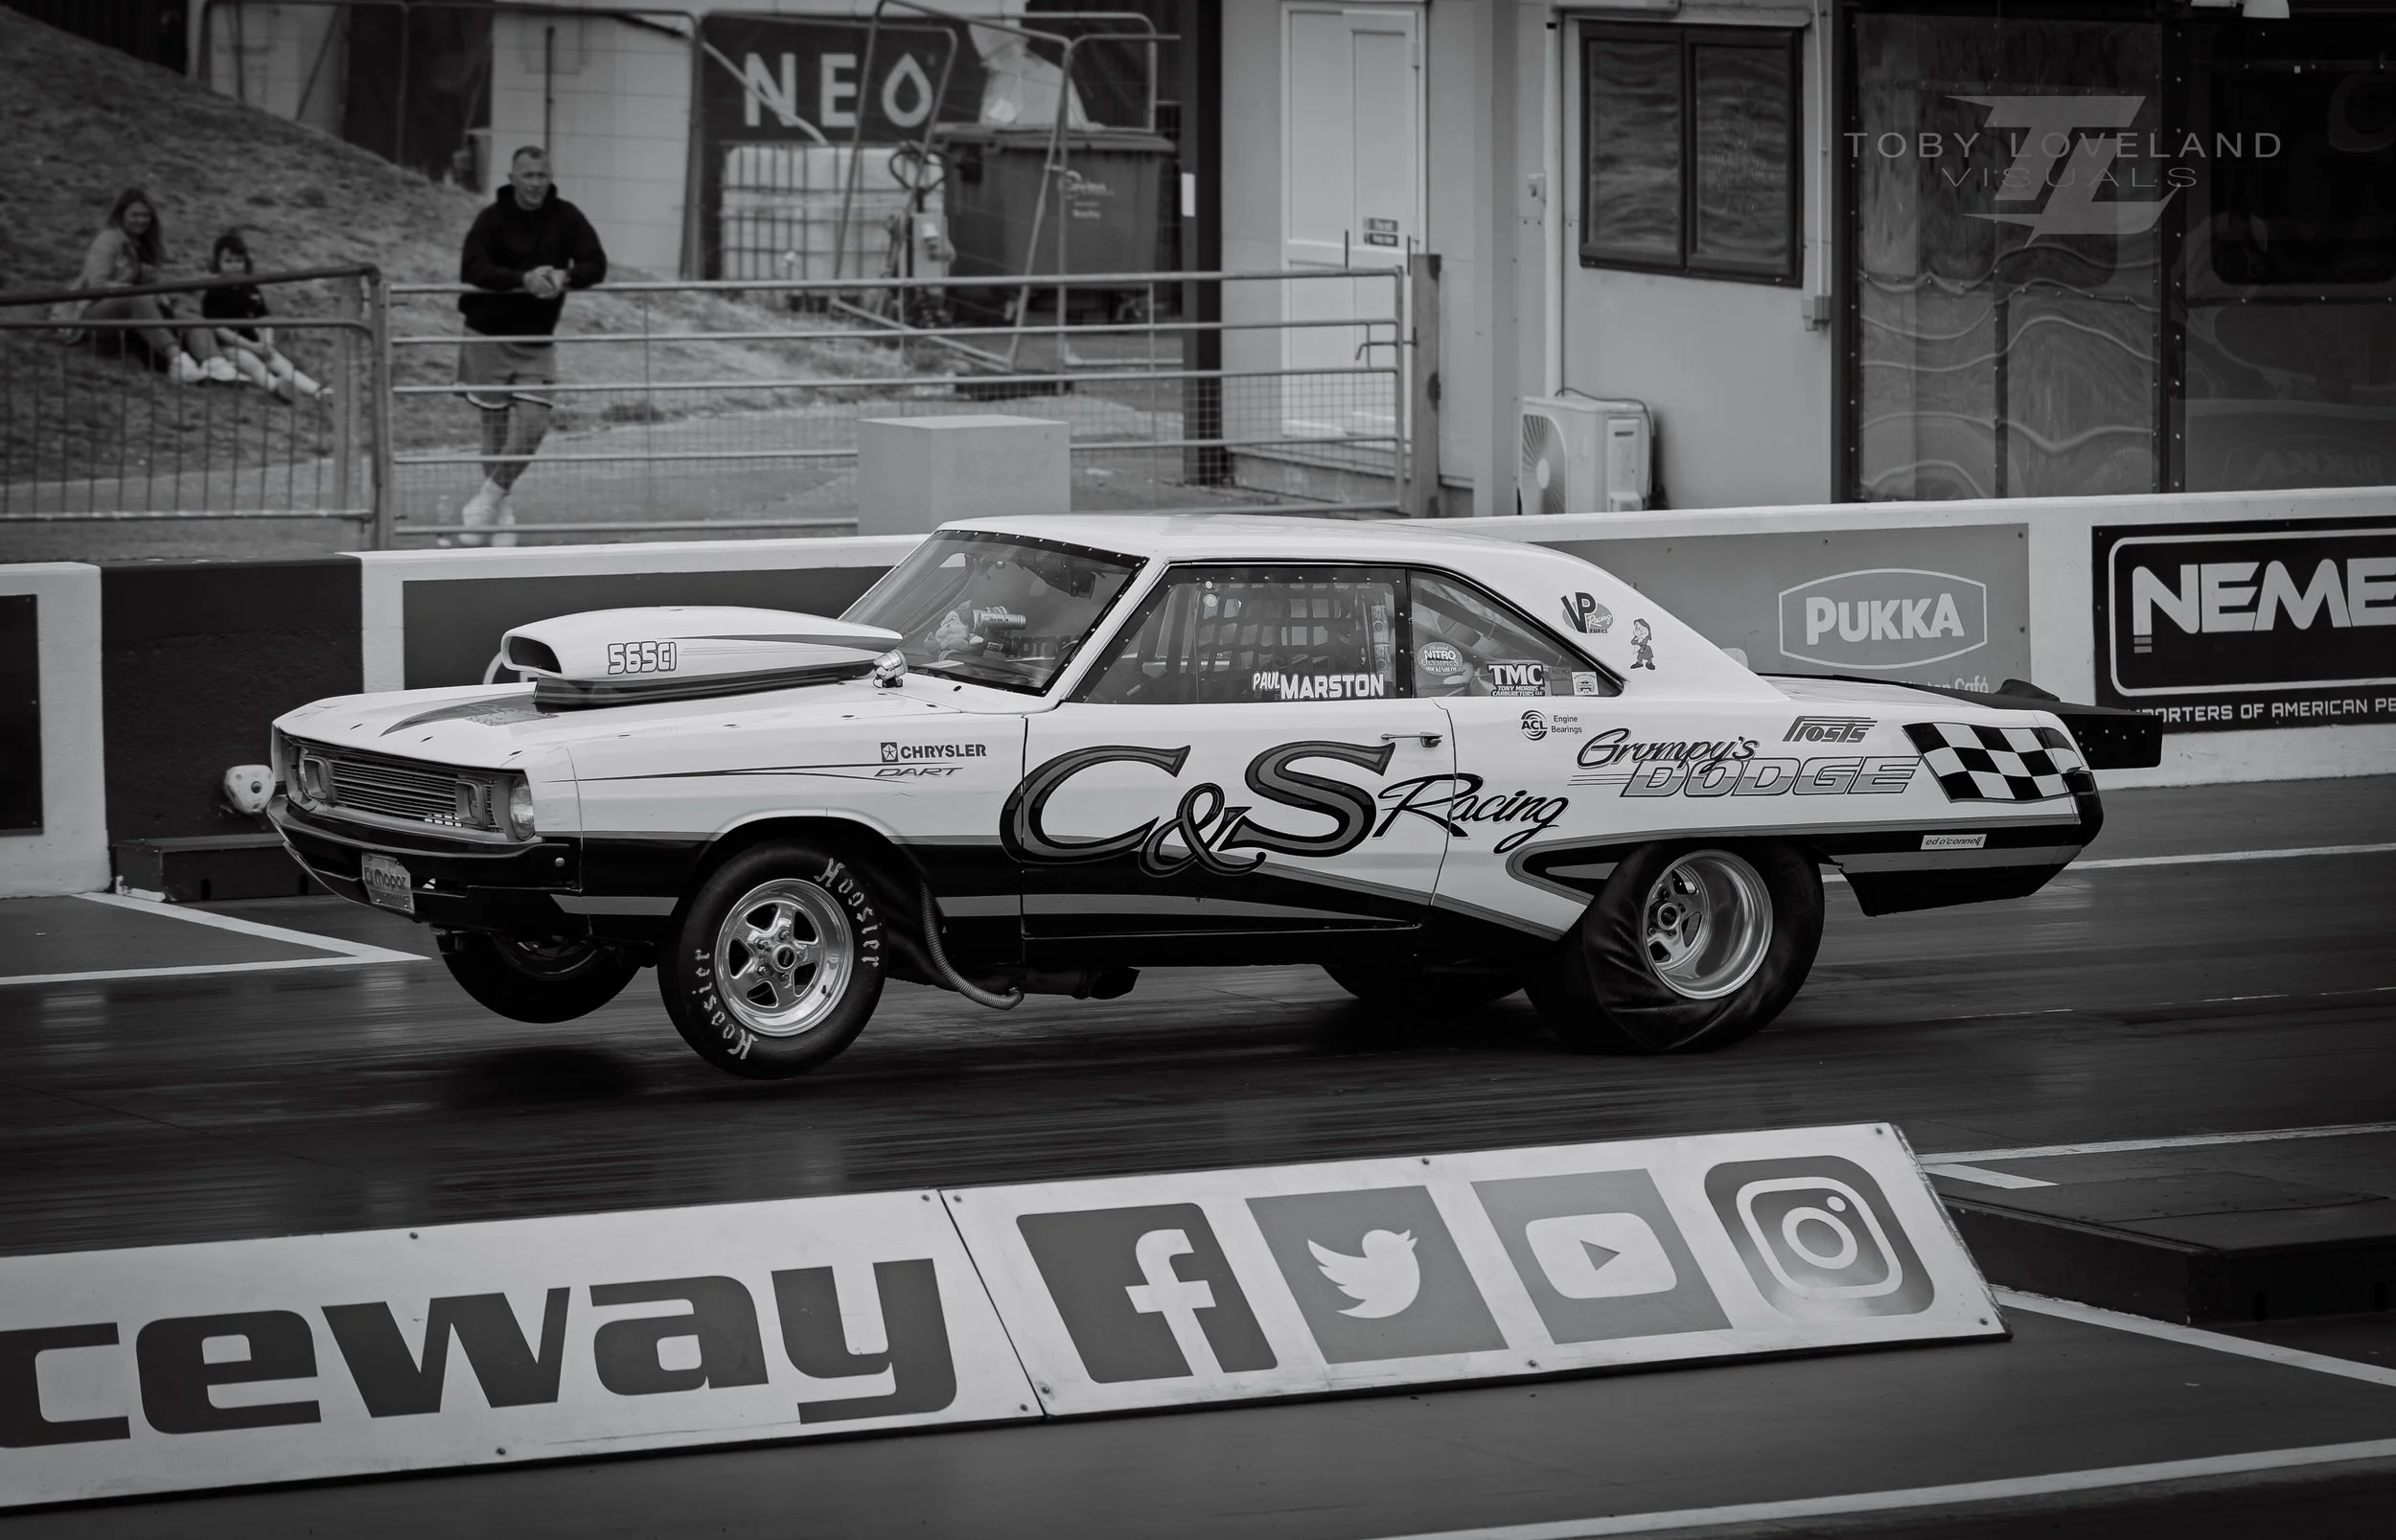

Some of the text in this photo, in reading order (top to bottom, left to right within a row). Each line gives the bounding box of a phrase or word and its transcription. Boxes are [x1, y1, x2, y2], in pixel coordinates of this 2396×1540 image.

[1560, 591, 1597, 633] VP
[1806, 592, 1965, 646] PUKKA
[608, 640, 677, 675] 565CI
[1421, 658, 1459, 667] OLYMPICS
[1424, 650, 1457, 660] NITRO
[1253, 672, 1384, 700] PAUL MARSTON
[1488, 664, 1544, 685] TMC
[1554, 715, 1578, 724] Engine
[2241, 703, 2265, 719] OF
[2271, 699, 2367, 718] AMERICAN
[2376, 698, 2396, 713] PE
[1521, 720, 1548, 730] ACL
[1551, 725, 1582, 734] Bearings
[901, 744, 987, 759] CHRYSLER
[1577, 728, 1759, 774] Grumpy's
[874, 767, 964, 777] DART
[1619, 756, 1924, 797] DODGE
[999, 741, 1569, 878] C&S Racing
[814, 858, 883, 968] Hoosier
[692, 949, 759, 1060] Hoosier
[0, 1257, 958, 1449] ceway
